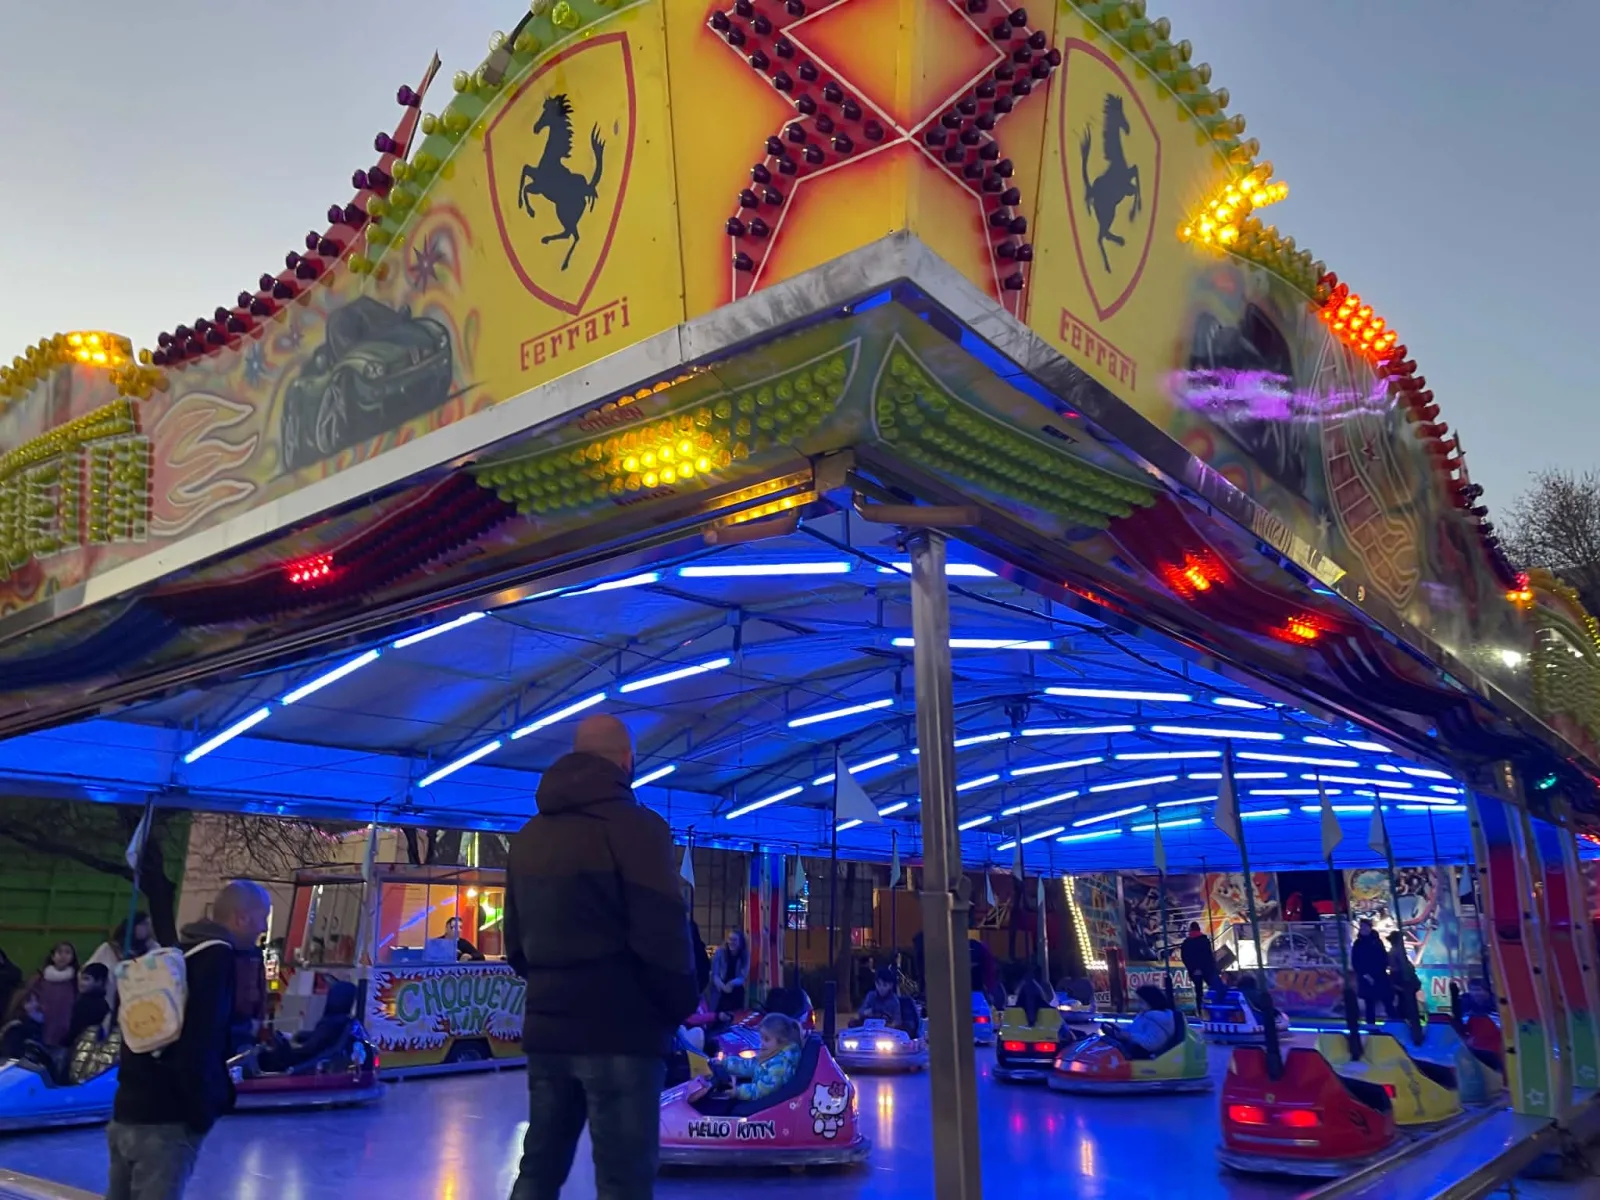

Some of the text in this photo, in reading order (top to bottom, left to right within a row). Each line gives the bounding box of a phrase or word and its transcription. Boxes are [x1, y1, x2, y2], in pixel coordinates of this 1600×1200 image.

[520, 296, 629, 371] Ferrari
[1060, 307, 1137, 391] Ferrari
[688, 1120, 775, 1140] HELLO KITTY
